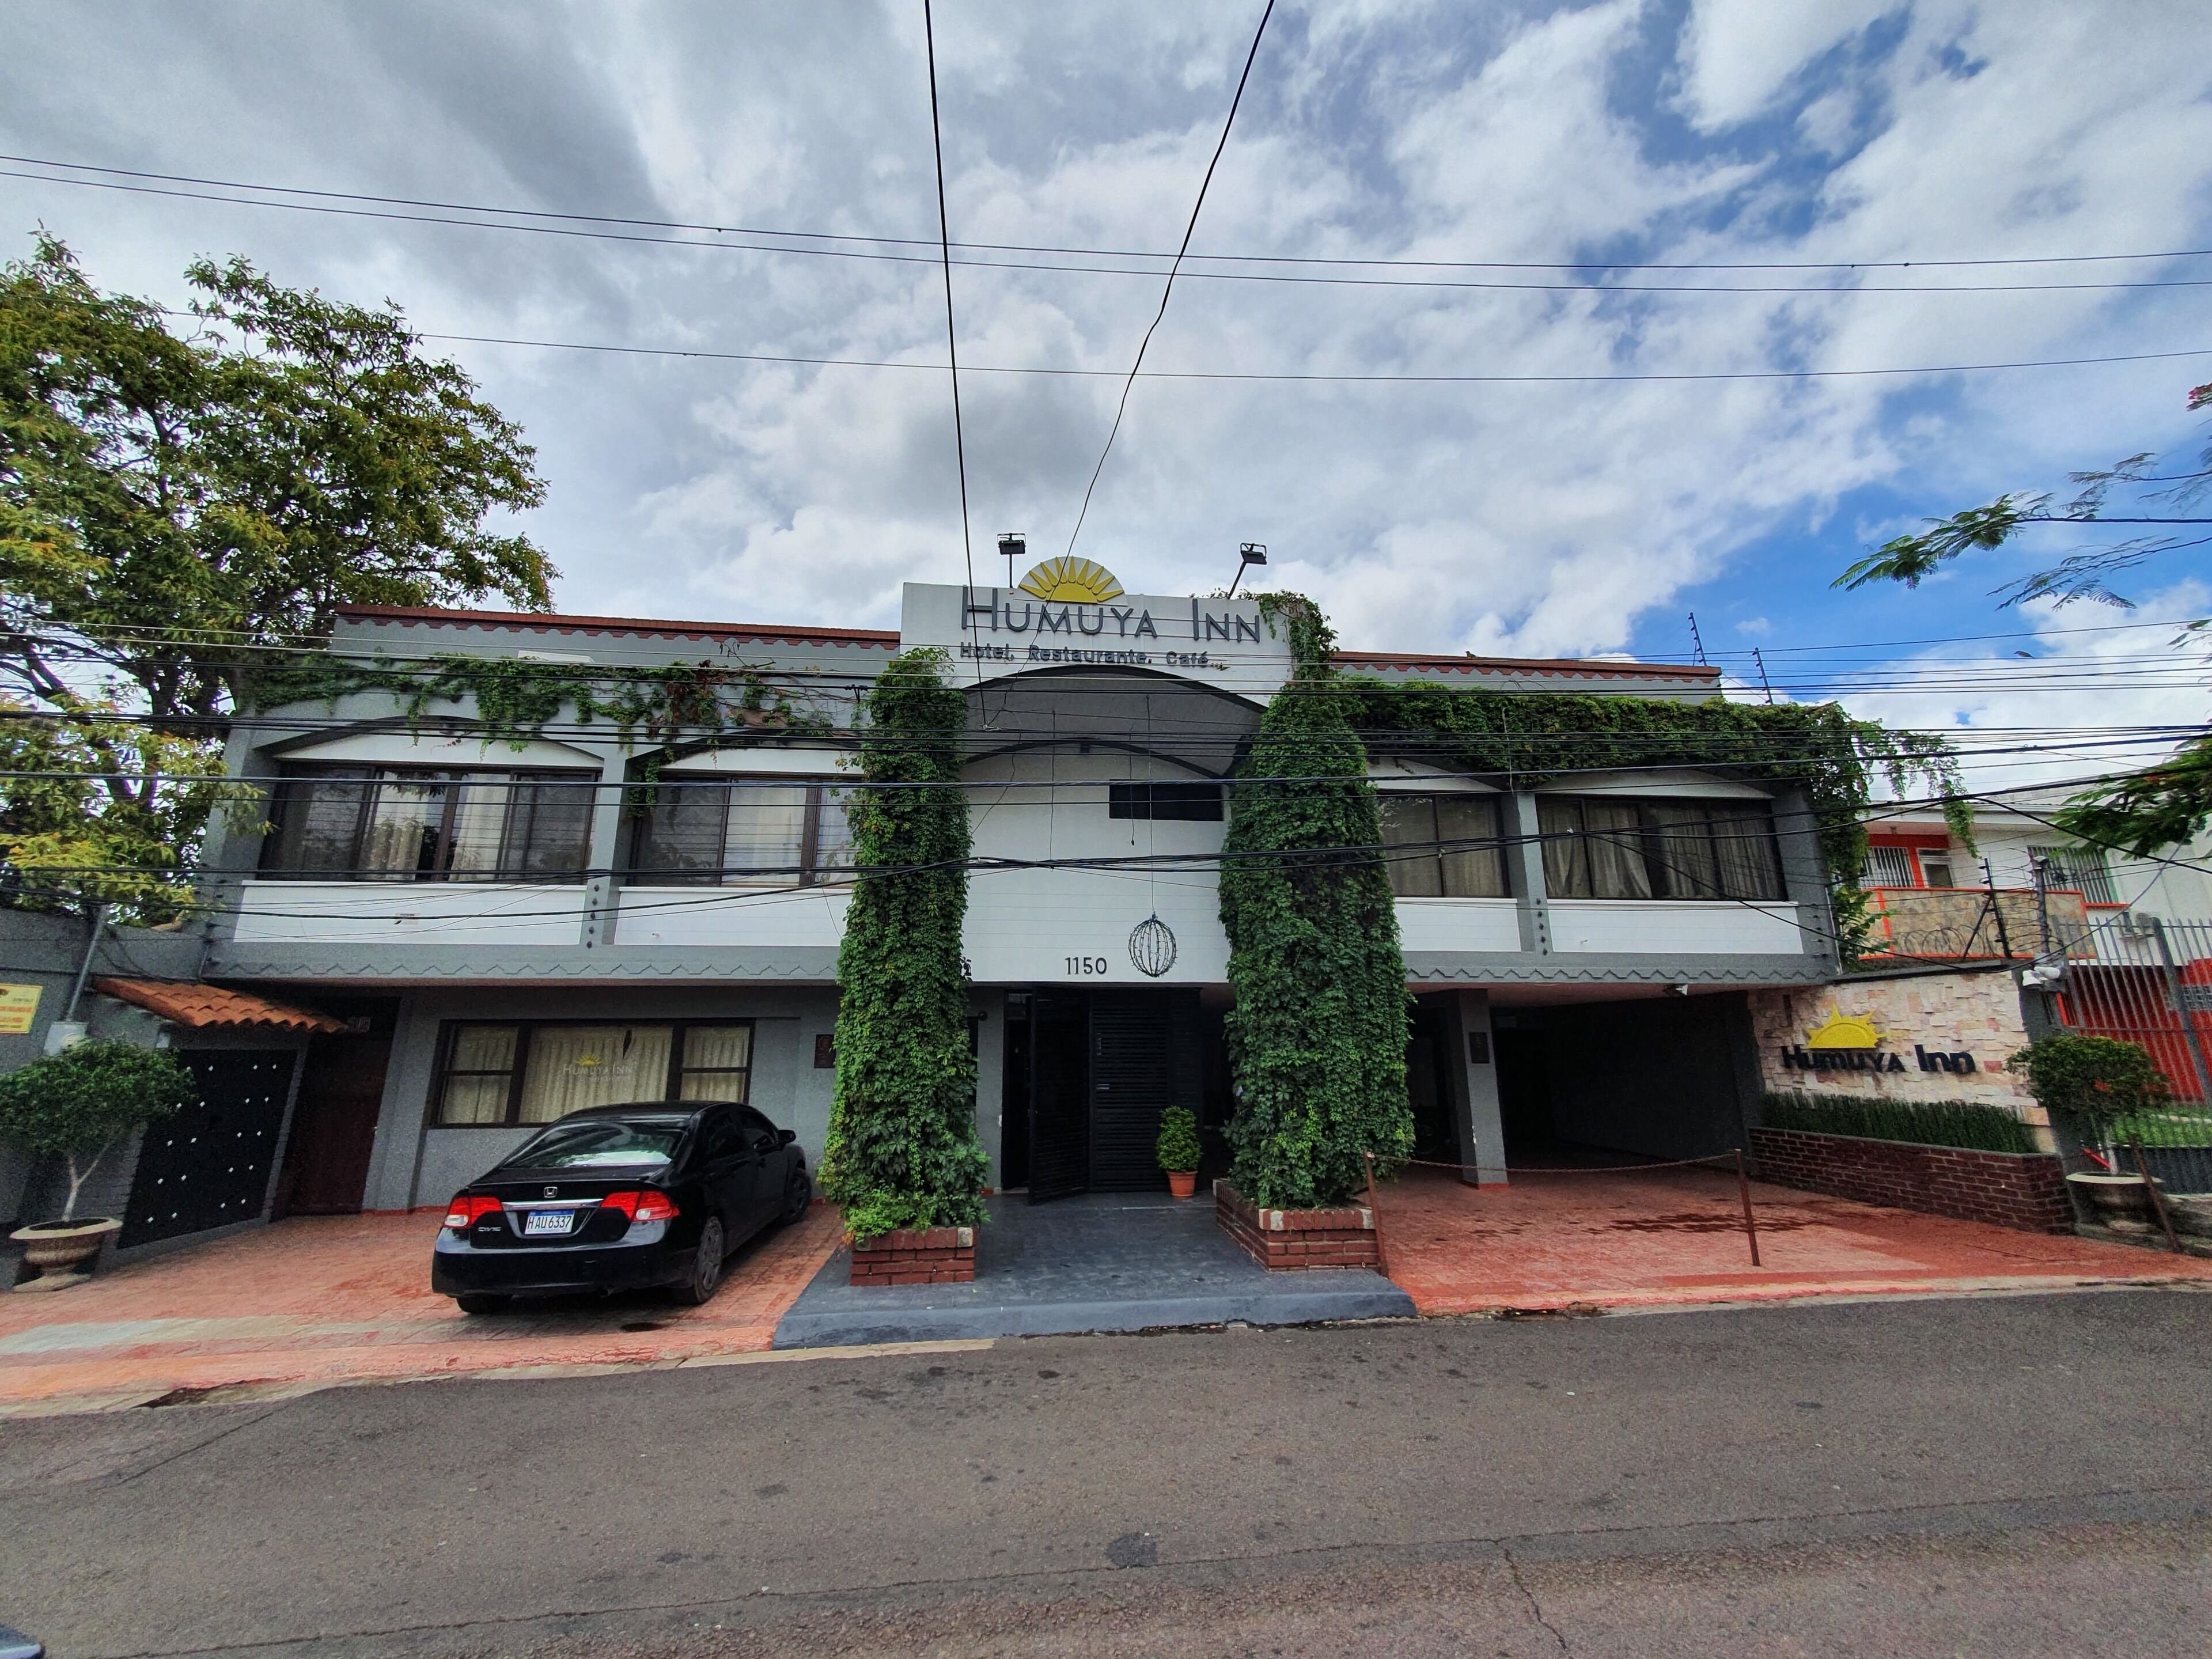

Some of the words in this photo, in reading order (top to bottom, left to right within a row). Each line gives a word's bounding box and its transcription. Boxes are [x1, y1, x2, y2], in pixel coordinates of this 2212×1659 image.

[961, 585, 1157, 638] HUMUYA
[1192, 598, 1261, 643] INN
[960, 641, 1014, 661] Hotel,
[1029, 645, 1152, 664] Restaurante,
[1166, 651, 1209, 668] Café
[1065, 957, 1107, 975] 1150
[1914, 1044, 1977, 1074] Inn
